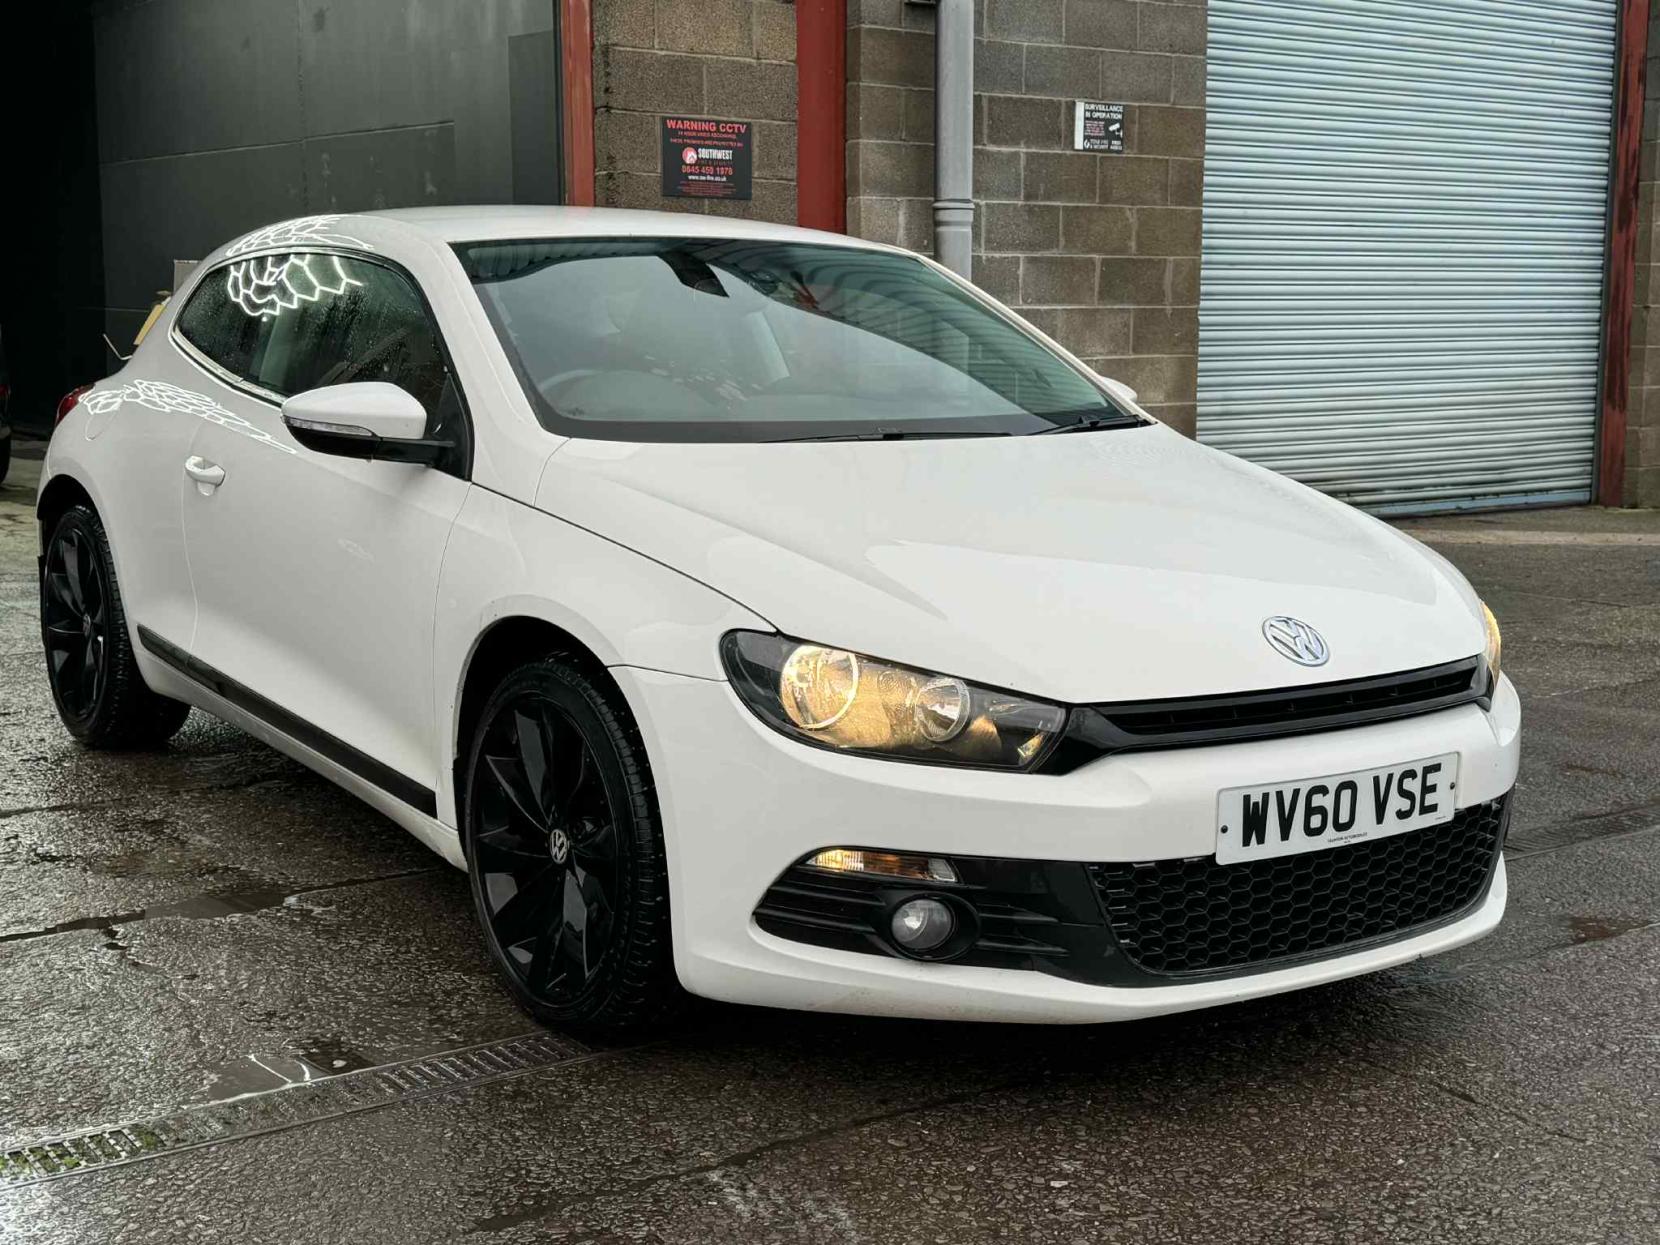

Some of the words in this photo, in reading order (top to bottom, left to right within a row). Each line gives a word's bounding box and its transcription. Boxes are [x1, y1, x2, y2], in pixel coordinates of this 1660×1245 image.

[1085, 103, 1123, 112] SURVEILLANCE
[666, 119, 717, 131] WARNING
[719, 123, 747, 133] CCTV
[698, 148, 733, 160] SOUTHWEST
[1242, 780, 1358, 847] WV60
[1372, 763, 1442, 825] VSE
